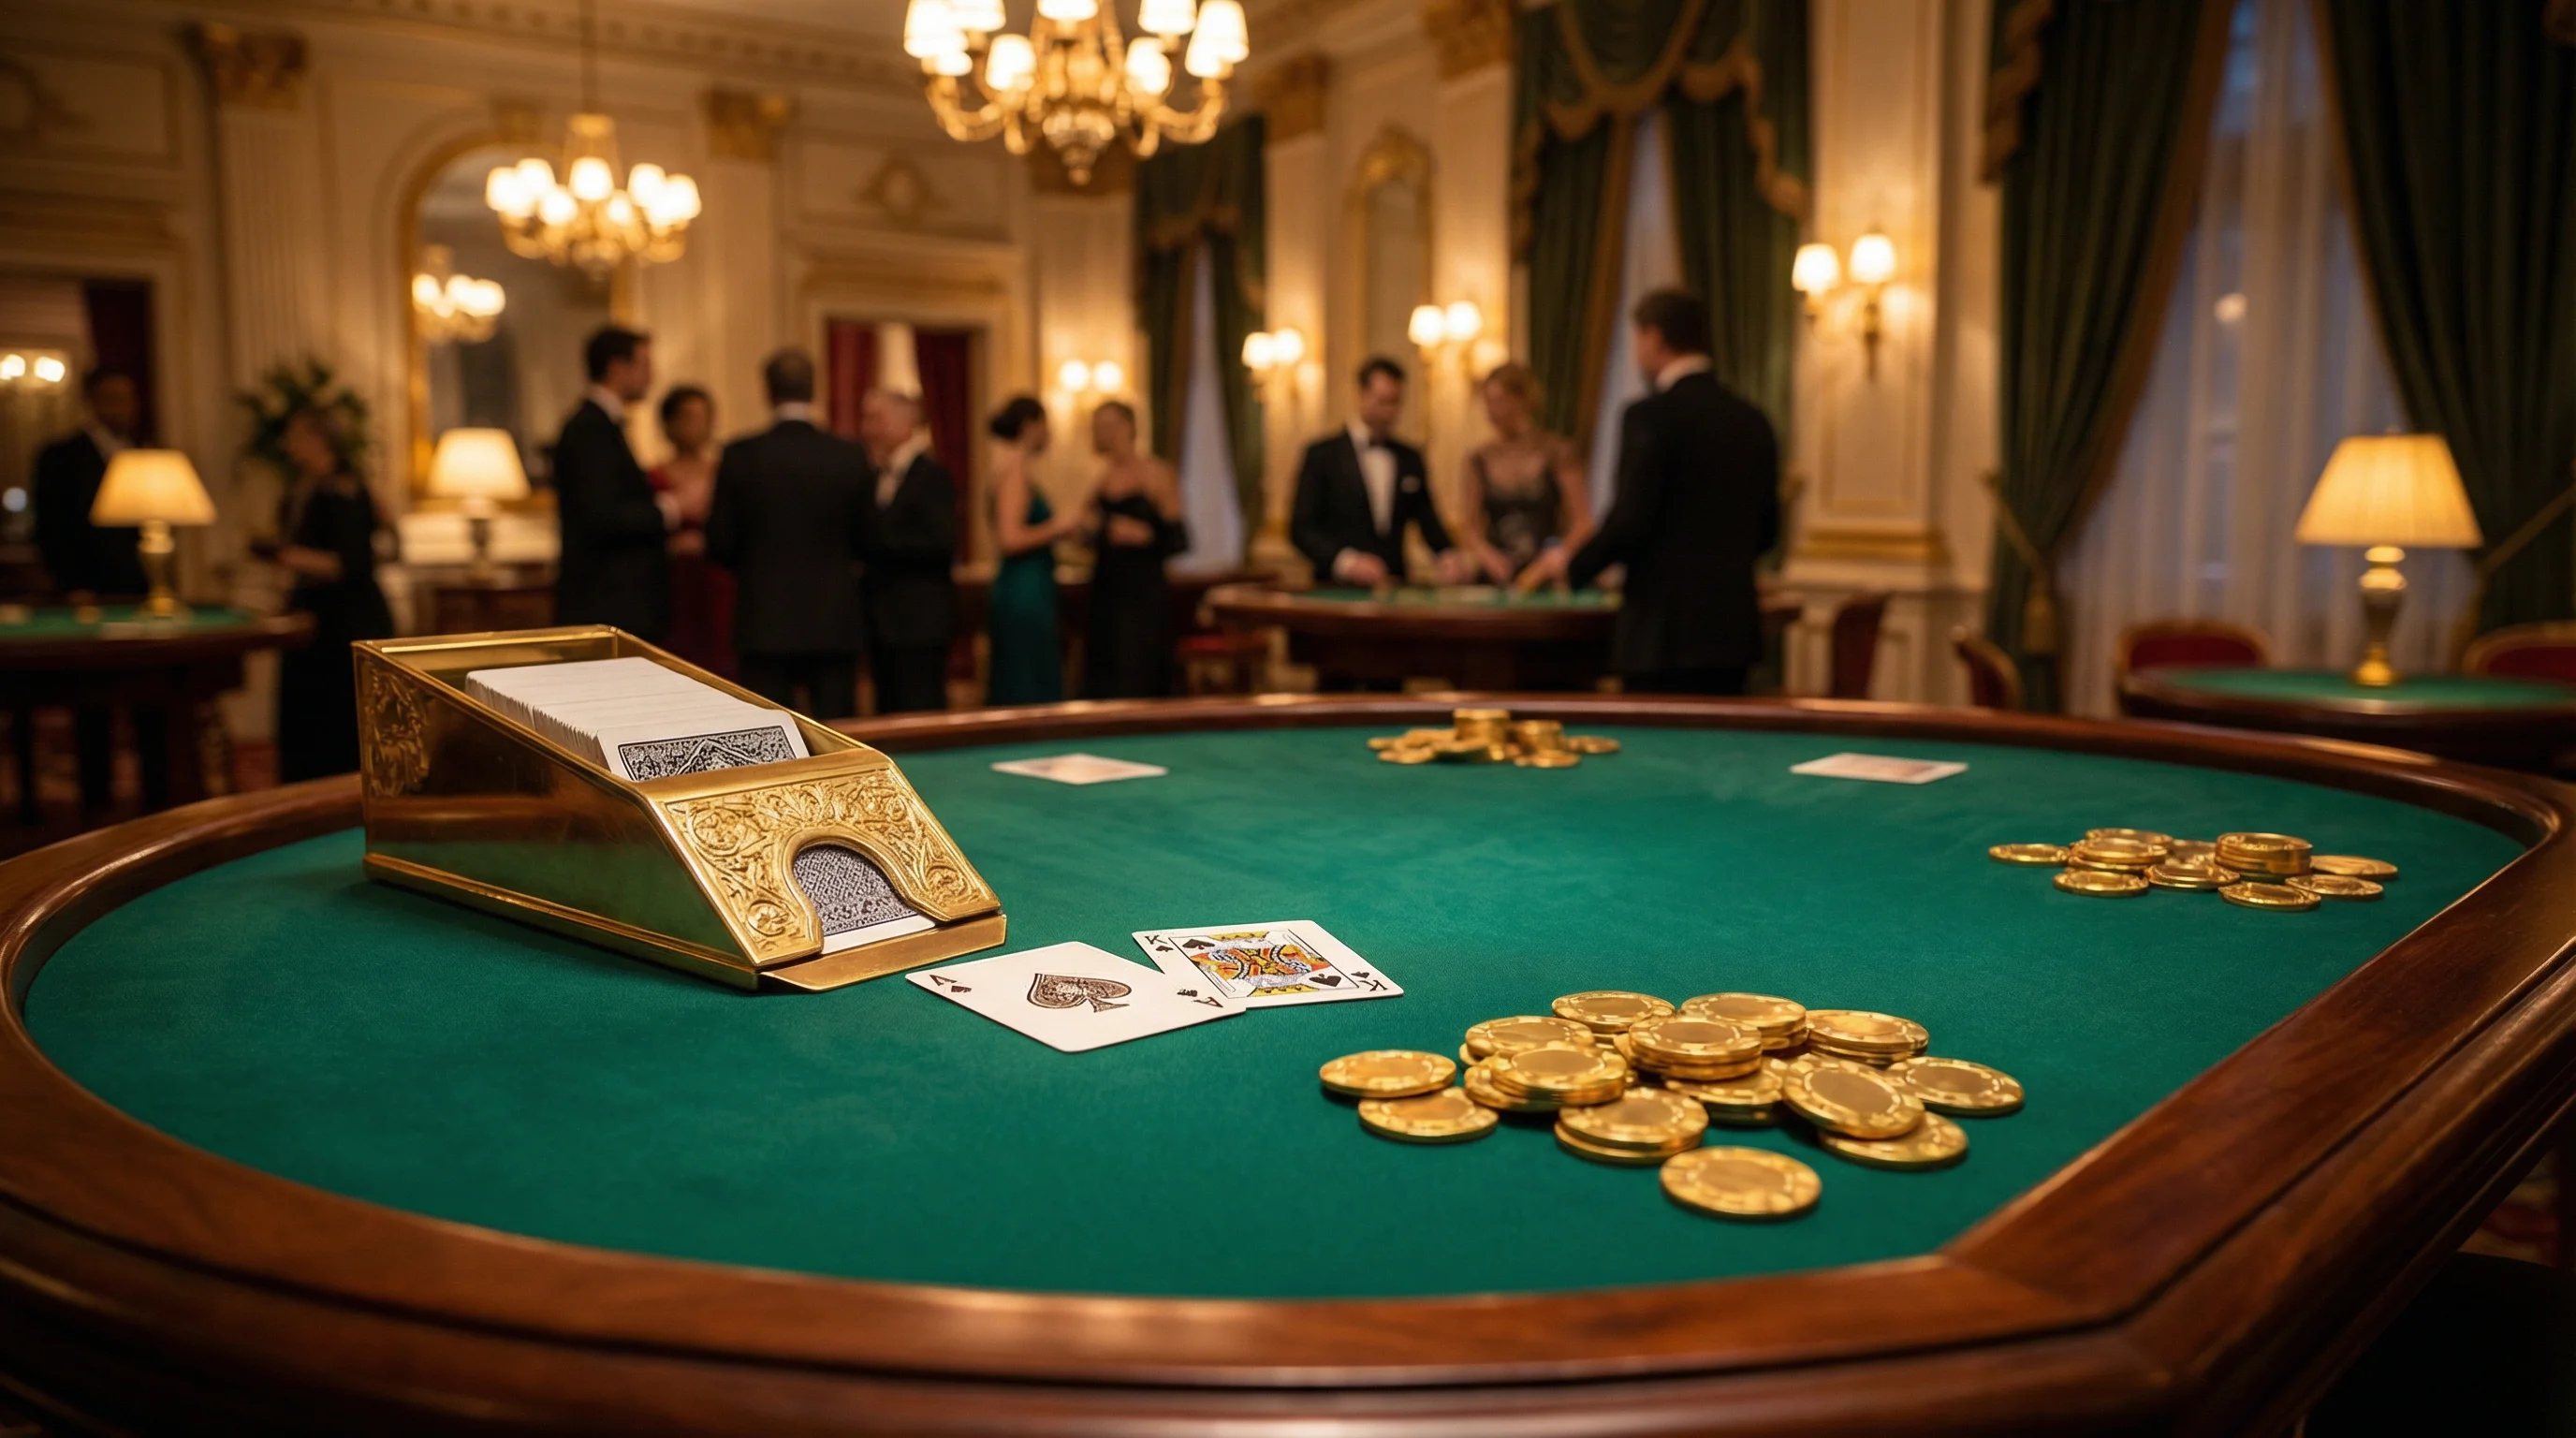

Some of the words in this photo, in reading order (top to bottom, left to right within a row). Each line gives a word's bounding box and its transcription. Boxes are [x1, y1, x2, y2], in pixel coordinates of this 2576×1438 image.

[1144, 934, 1168, 945] K
[929, 974, 958, 987] A
[1357, 979, 1388, 992] K
[1192, 996, 1224, 1008] A
